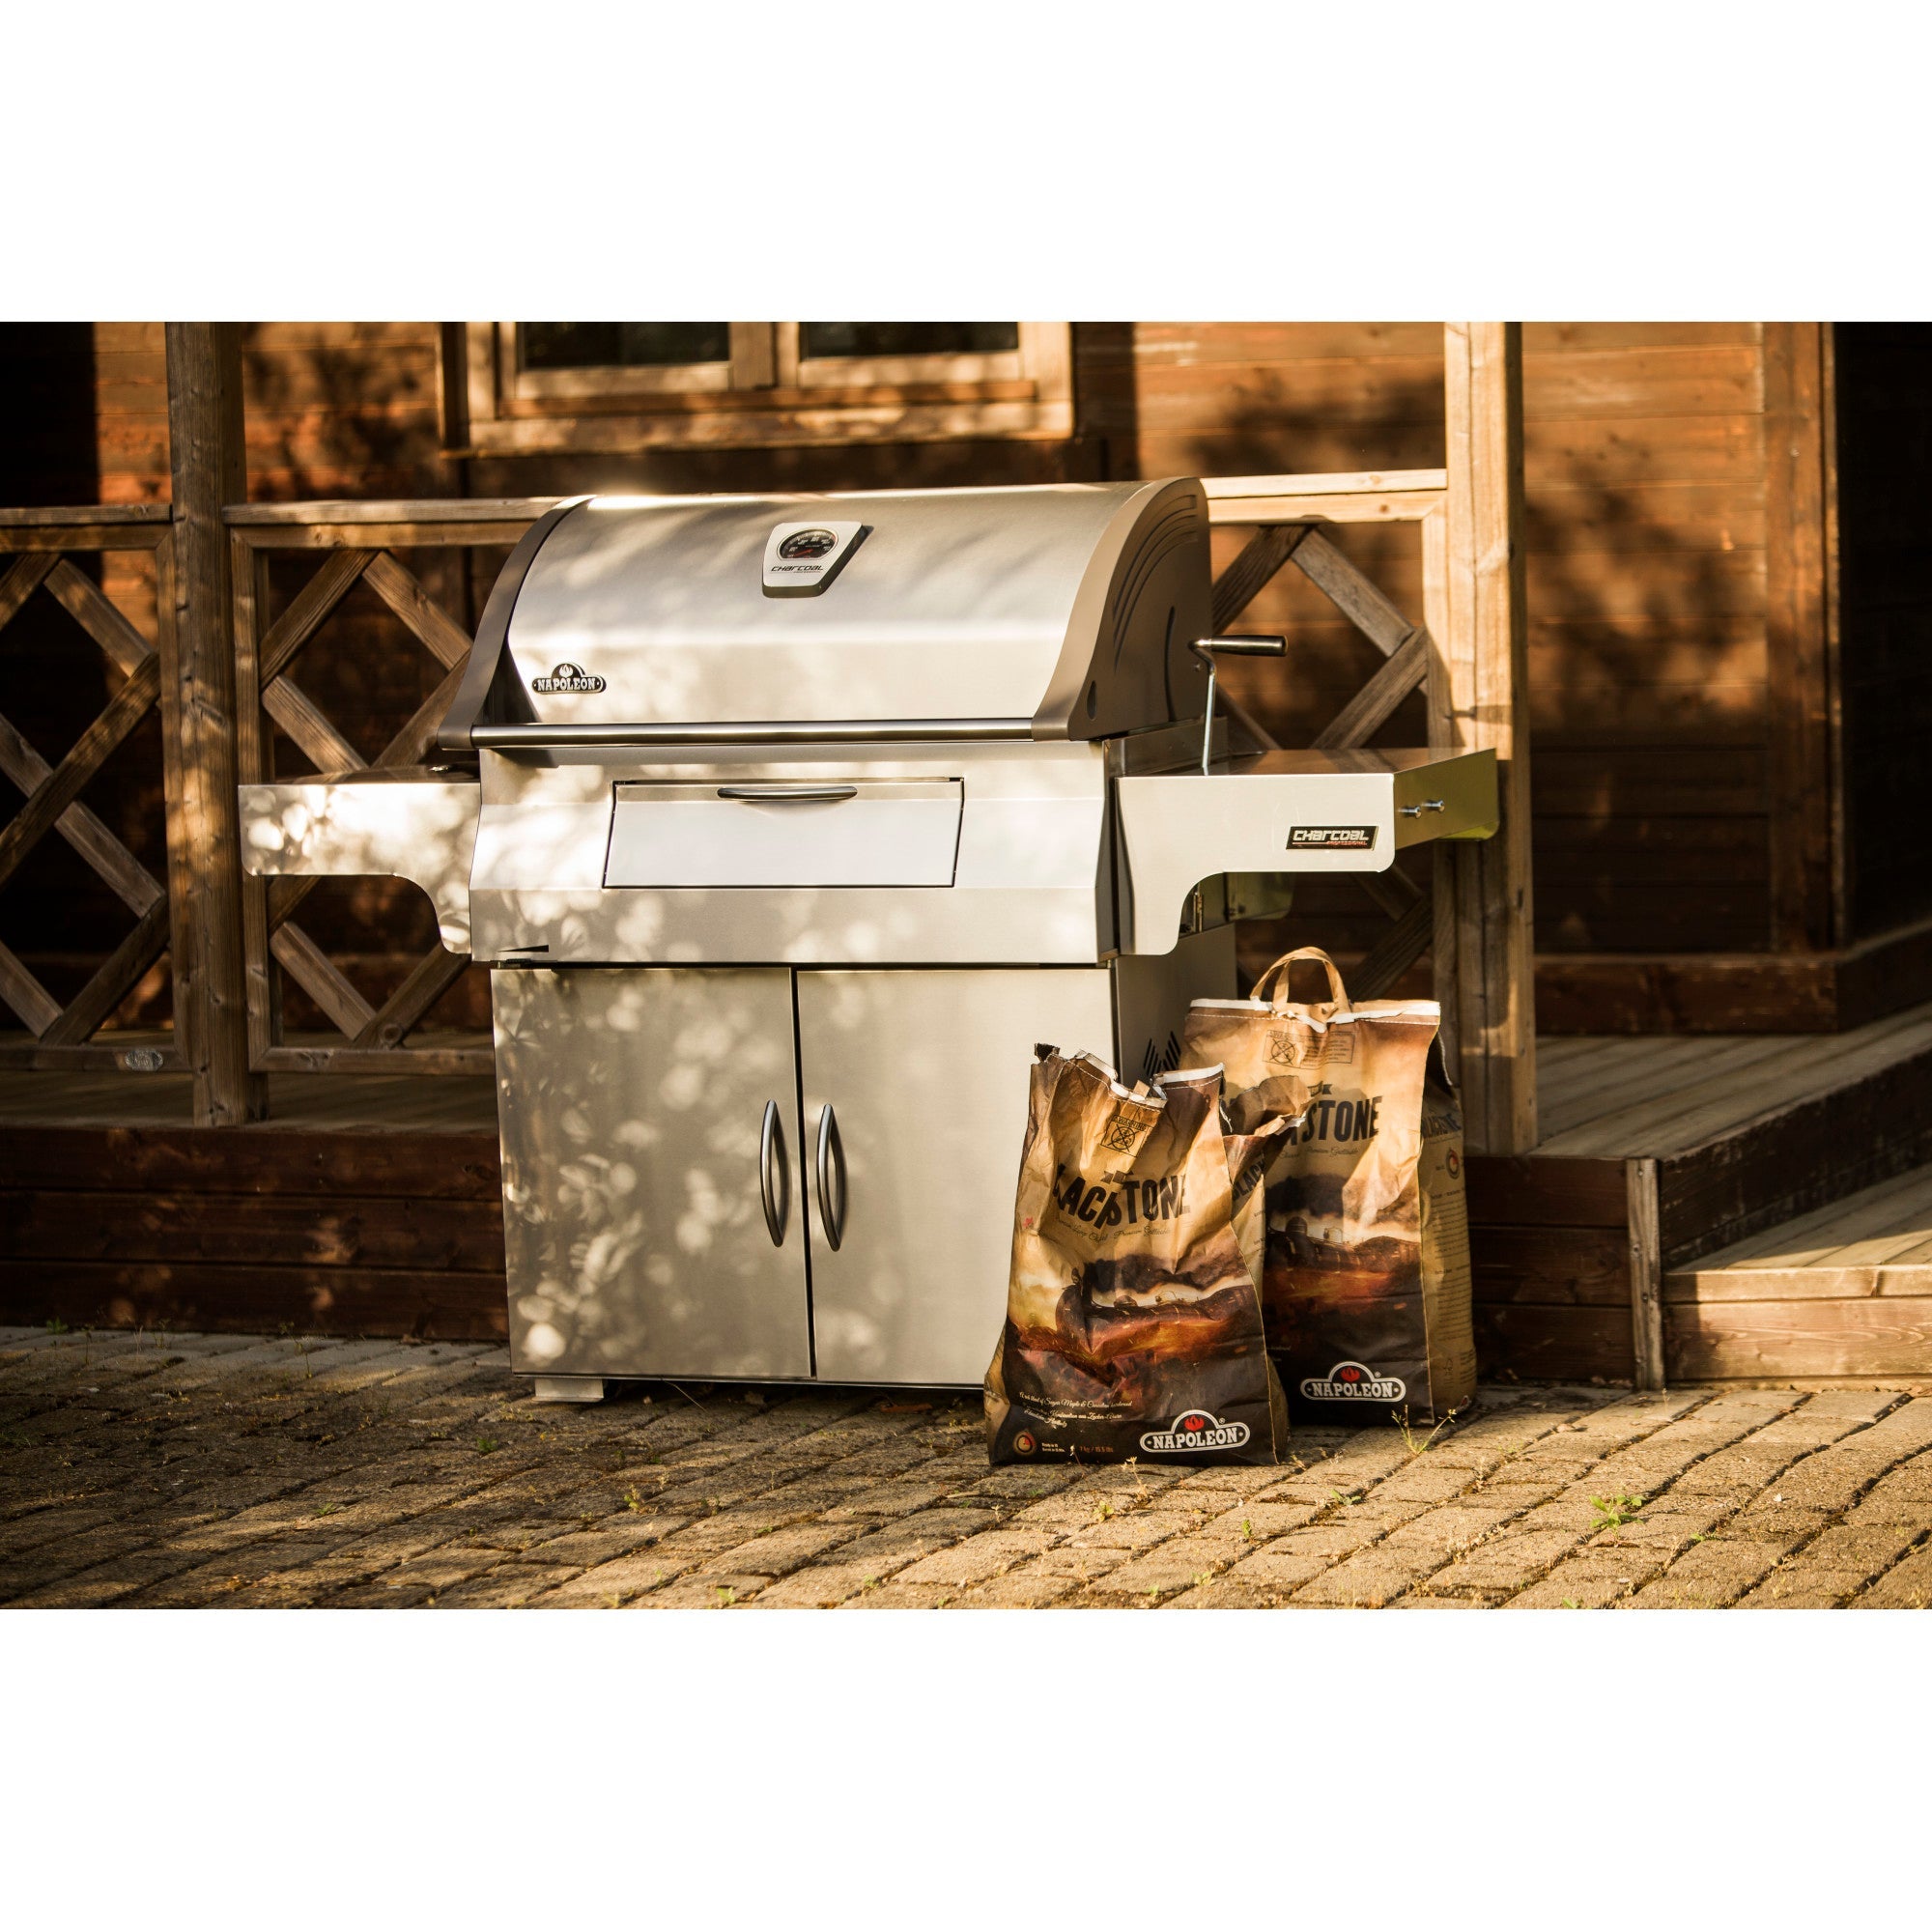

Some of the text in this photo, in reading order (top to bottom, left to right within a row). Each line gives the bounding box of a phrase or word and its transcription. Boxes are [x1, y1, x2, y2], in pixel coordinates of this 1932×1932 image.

[537, 677, 596, 692] NAPOLEON
[1311, 1382, 1393, 1398] NAPOLEON
[1152, 1427, 1237, 1449] NAPOLEON
